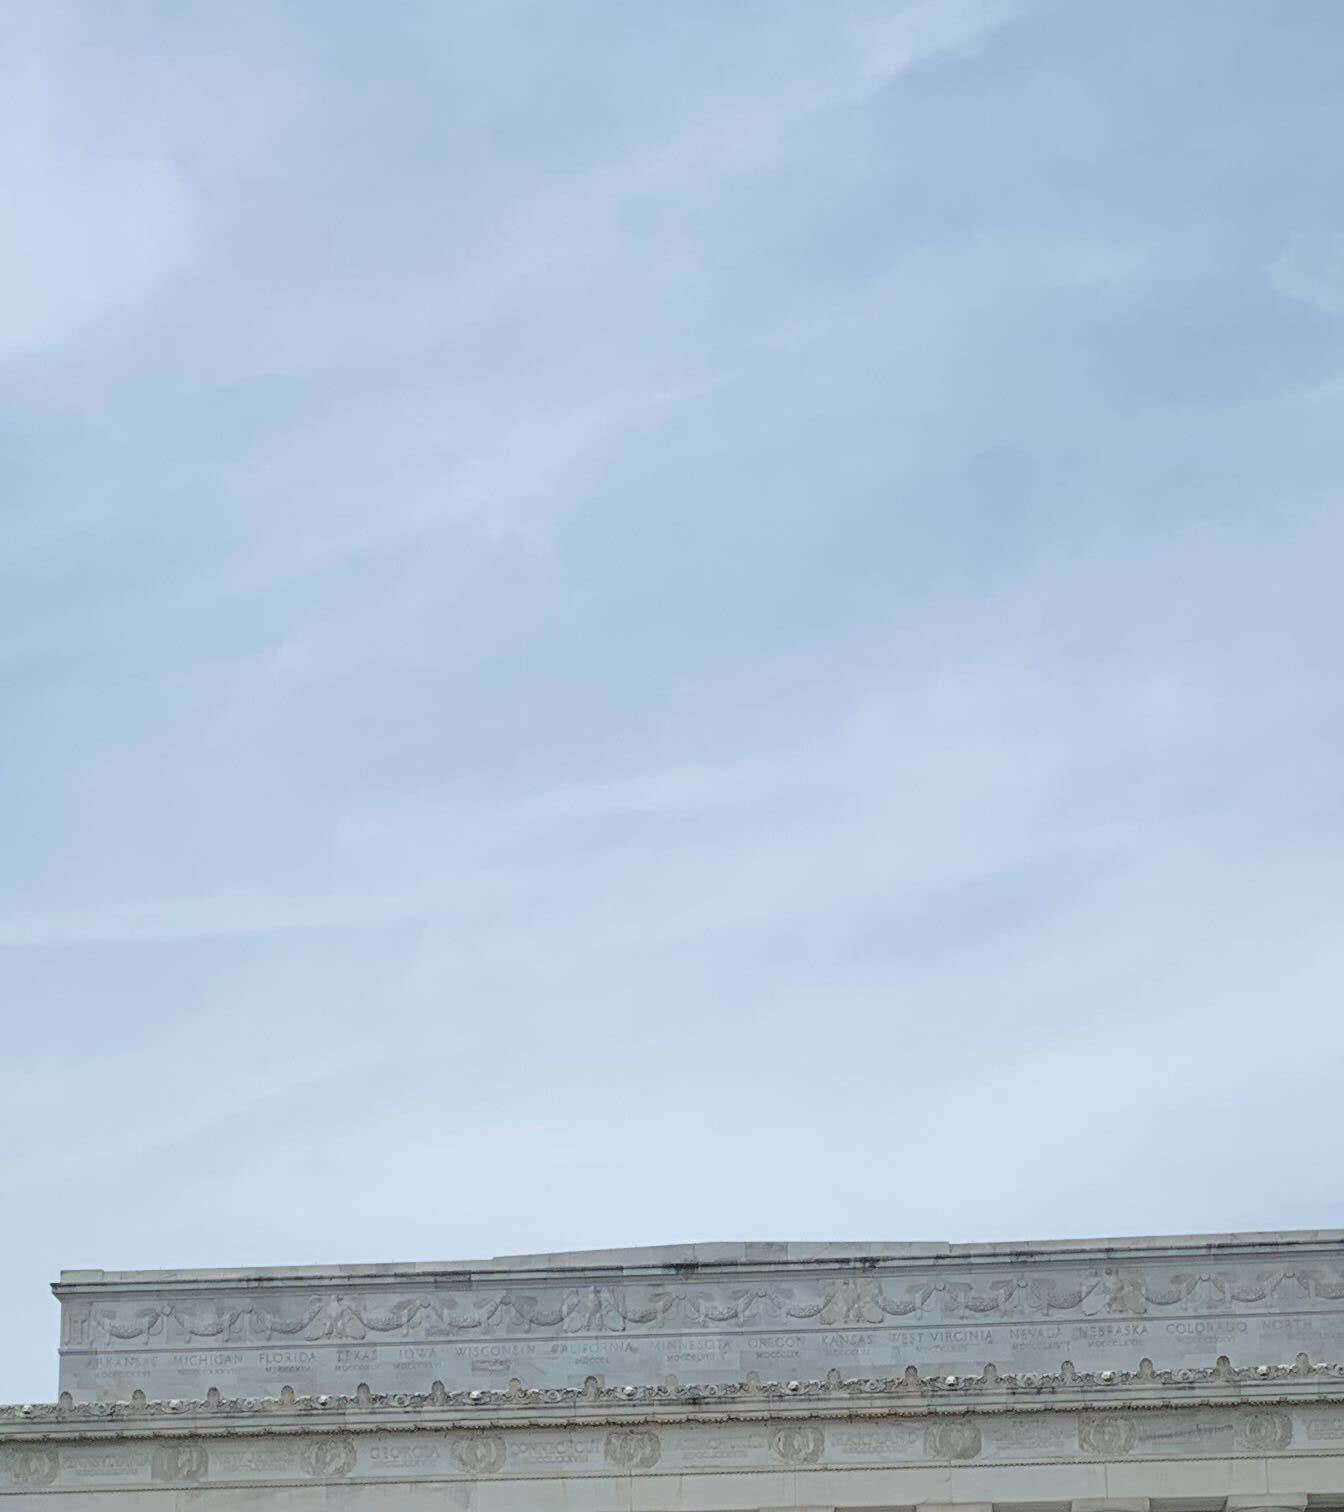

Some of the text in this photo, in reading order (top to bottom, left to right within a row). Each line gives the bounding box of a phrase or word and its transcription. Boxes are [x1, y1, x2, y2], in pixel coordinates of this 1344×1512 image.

[930, 1328, 993, 1342] VIRGINIA
[1077, 1323, 1149, 1338] NEBRASKA
[820, 1333, 873, 1346] KANSAS
[336, 1348, 377, 1362] TEXAS
[455, 1344, 536, 1357] WISCONSIN
[172, 1354, 244, 1367] MICHIGAN
[258, 1351, 316, 1364] FLORIDA
